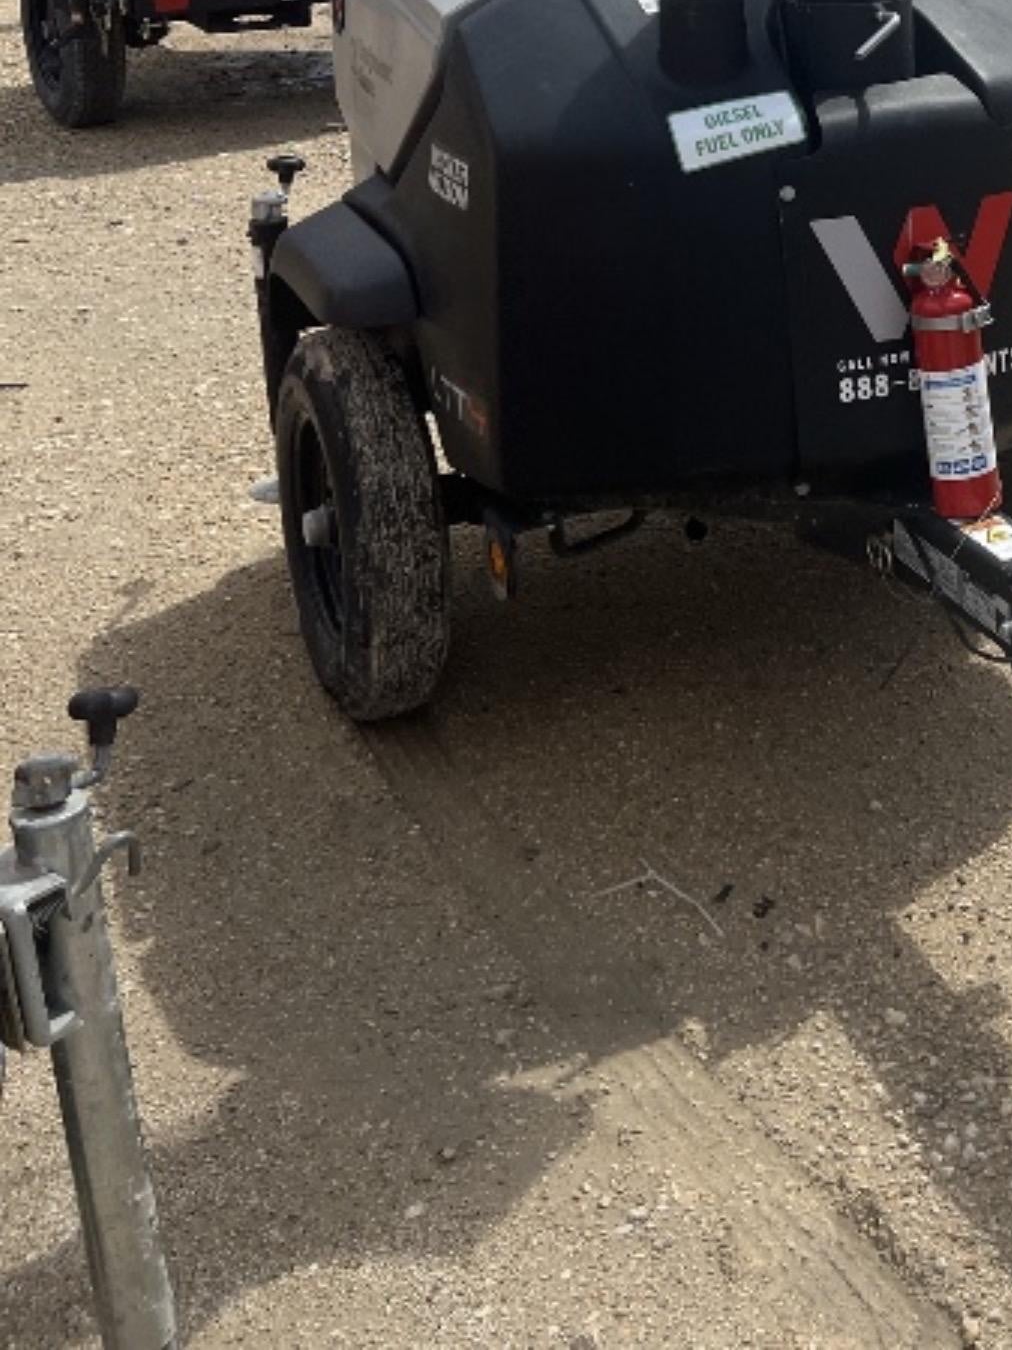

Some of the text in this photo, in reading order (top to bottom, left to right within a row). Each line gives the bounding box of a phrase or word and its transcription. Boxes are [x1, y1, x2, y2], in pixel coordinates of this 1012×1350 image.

[703, 103, 764, 130] DIESEL
[695, 118, 785, 157] FUEL ONLY
